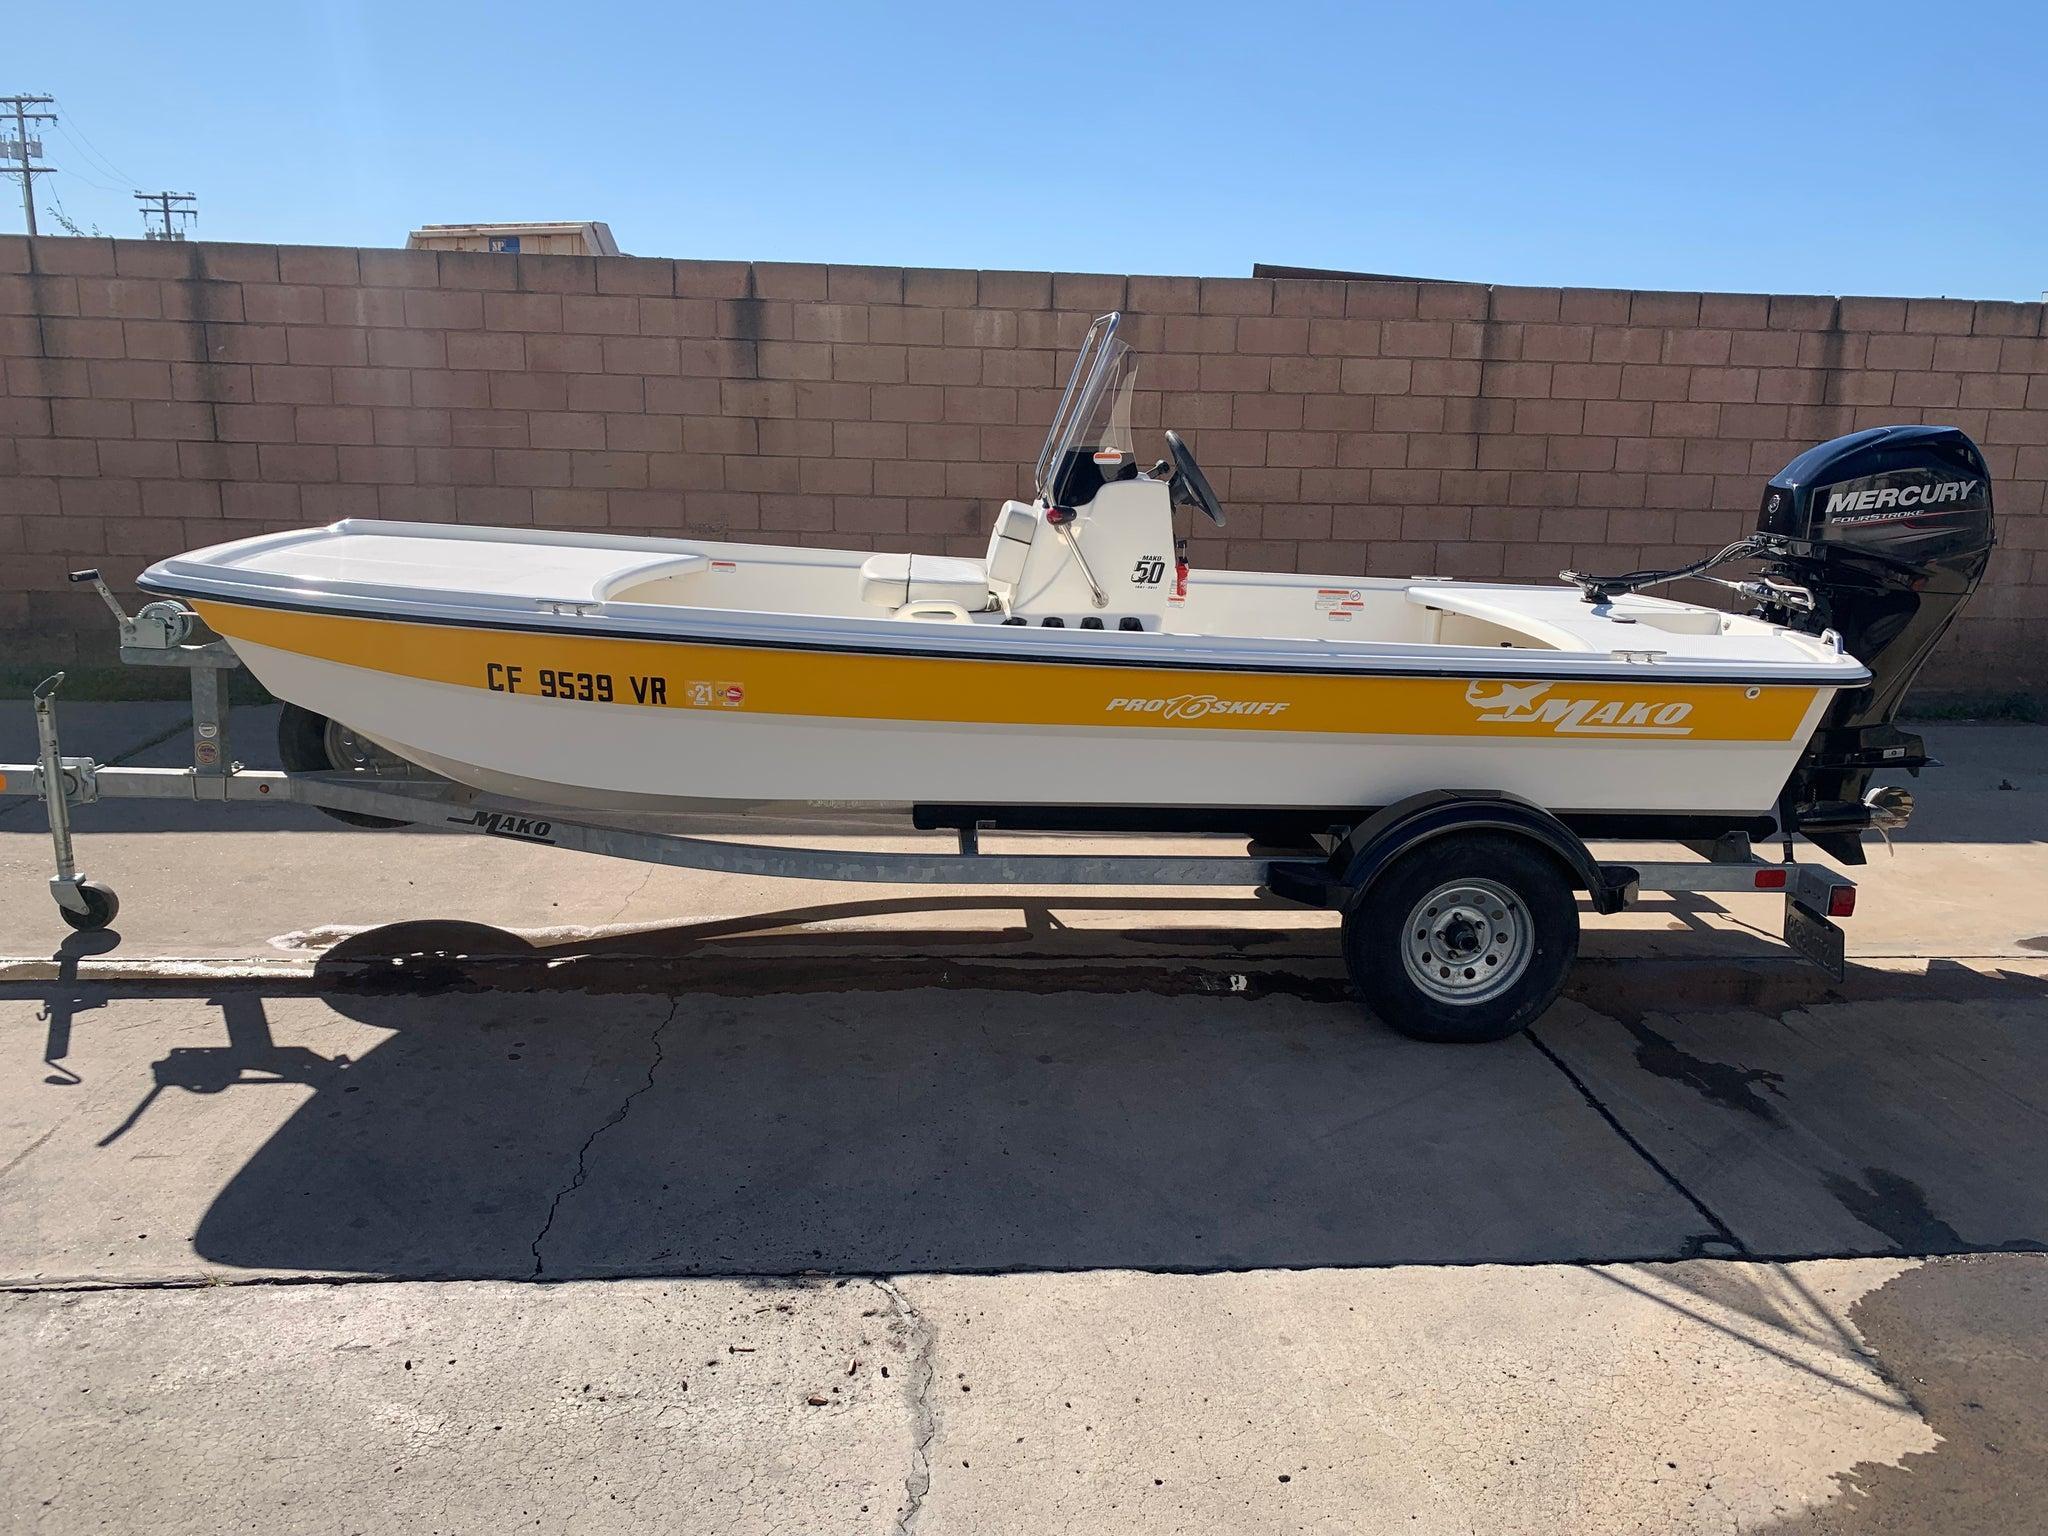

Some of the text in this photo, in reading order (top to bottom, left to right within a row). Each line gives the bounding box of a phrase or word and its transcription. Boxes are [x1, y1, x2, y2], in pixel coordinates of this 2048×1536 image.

[1825, 480, 1978, 513] MERCURY
[1831, 510, 1925, 524] FOURSTROKE
[1131, 561, 1165, 584] 50
[487, 663, 667, 704] CF 9539 VR
[1105, 698, 1166, 712] PRO
[1209, 701, 1290, 715] SKIFF
[1532, 699, 1694, 734] MAKO
[473, 811, 555, 844] MAKO
